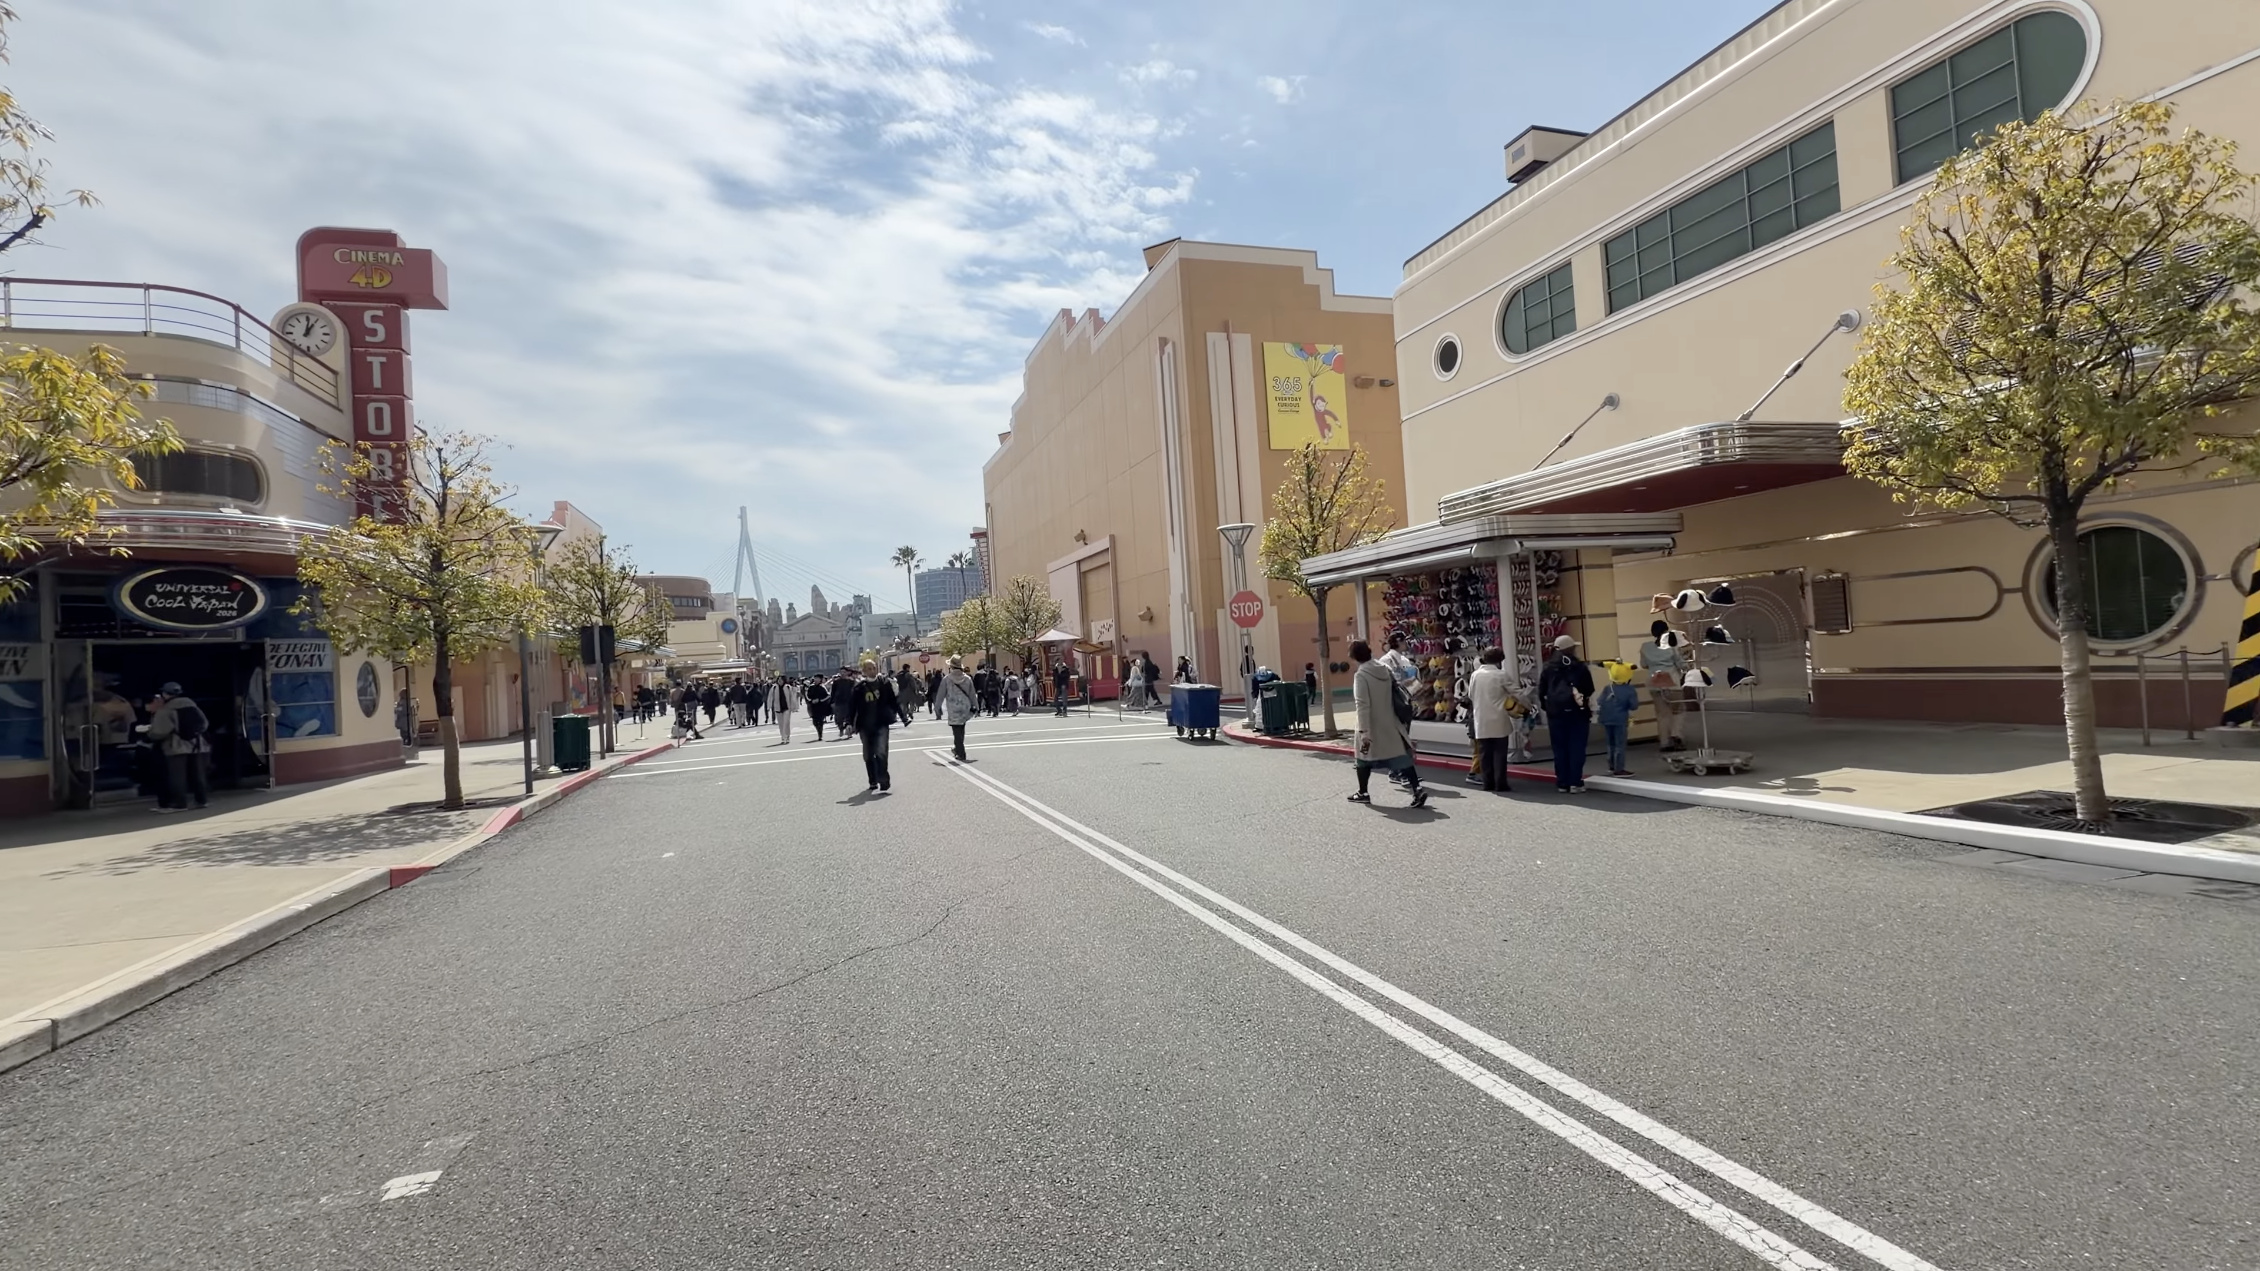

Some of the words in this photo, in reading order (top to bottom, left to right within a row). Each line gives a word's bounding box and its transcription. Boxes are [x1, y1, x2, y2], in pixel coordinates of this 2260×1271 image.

[333, 248, 404, 267] CINEMA
[1272, 376, 1302, 392] 365
[155, 583, 231, 594] UNIVERSAL
[1231, 602, 1261, 617] STOP
